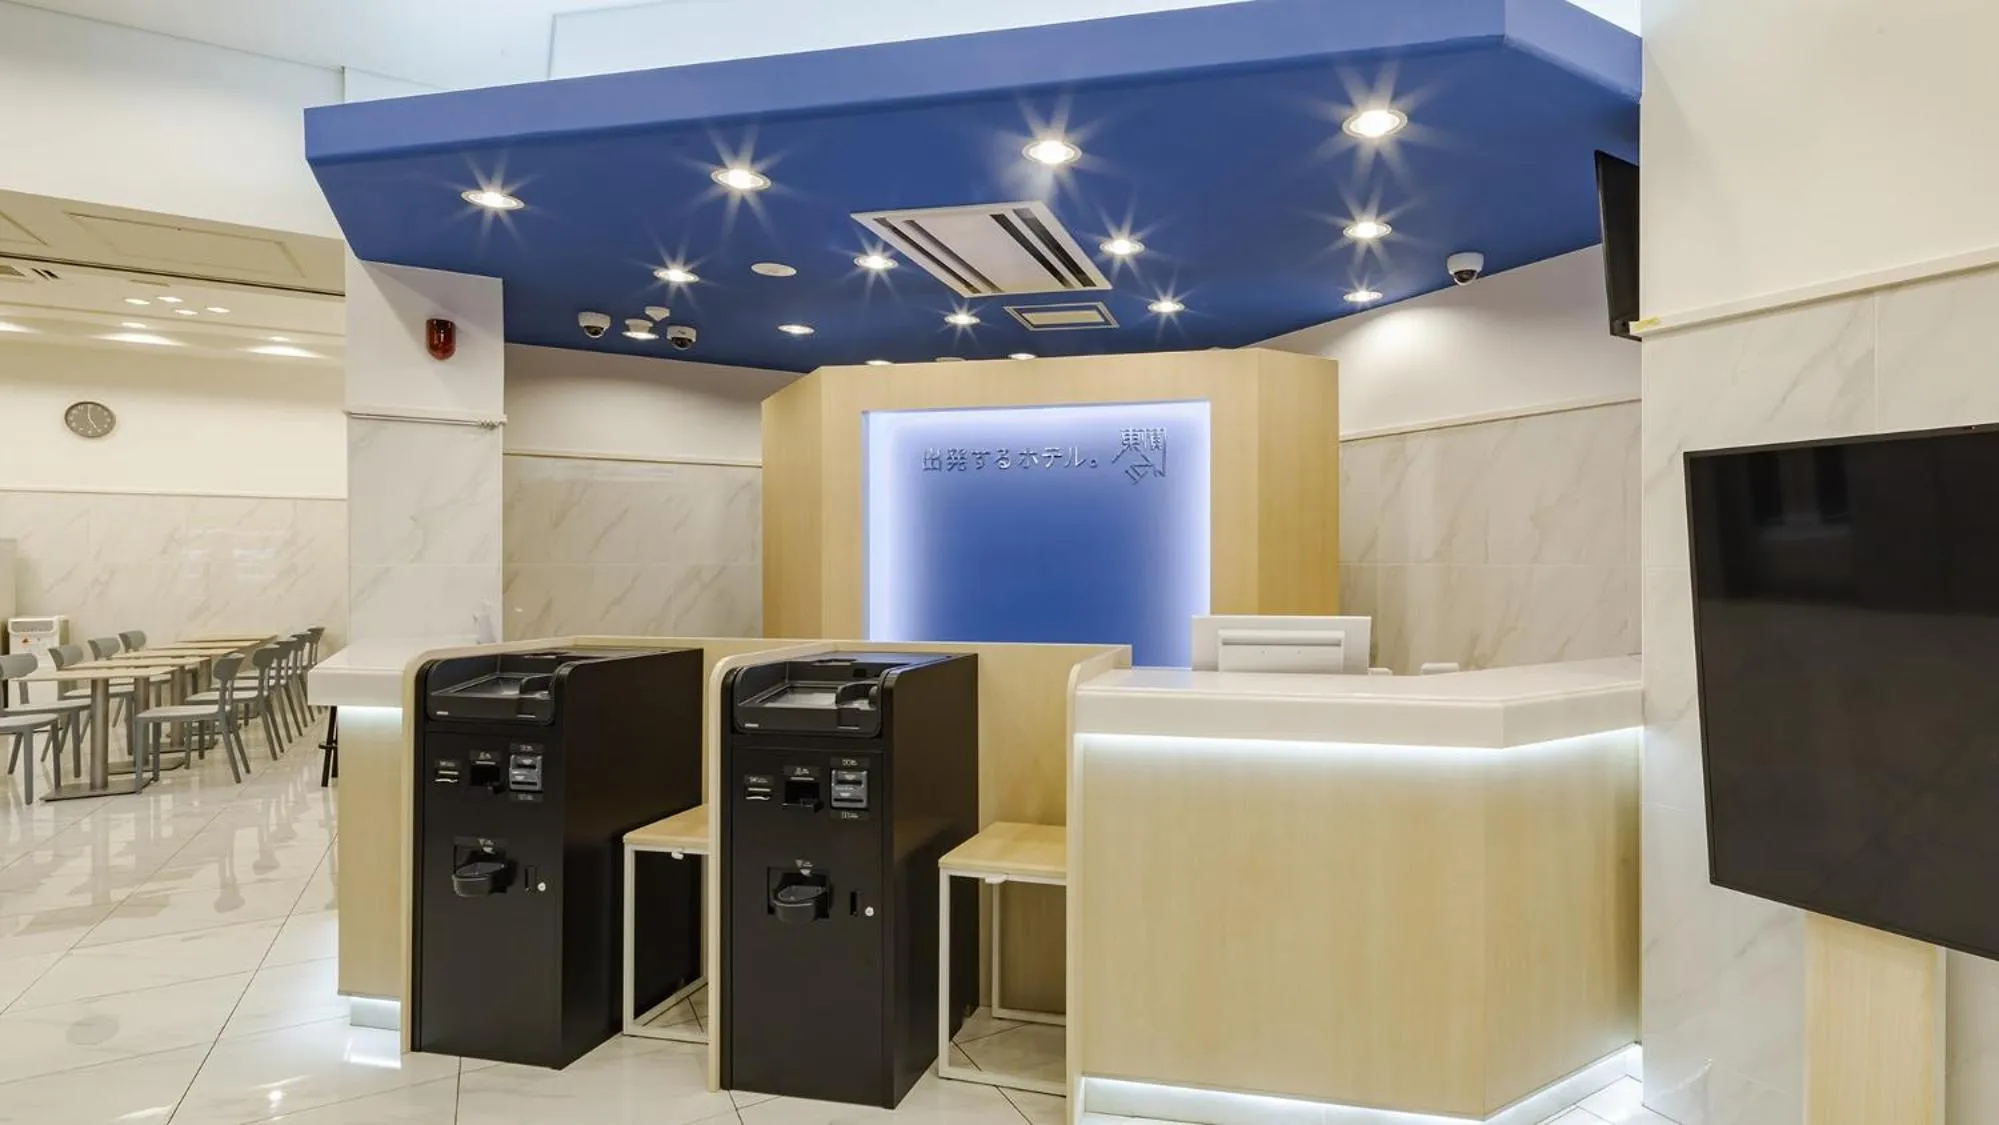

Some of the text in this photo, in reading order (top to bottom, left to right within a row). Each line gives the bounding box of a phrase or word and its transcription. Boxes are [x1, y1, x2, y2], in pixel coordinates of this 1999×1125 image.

[922, 446, 1099, 472] 出発するホテル。
